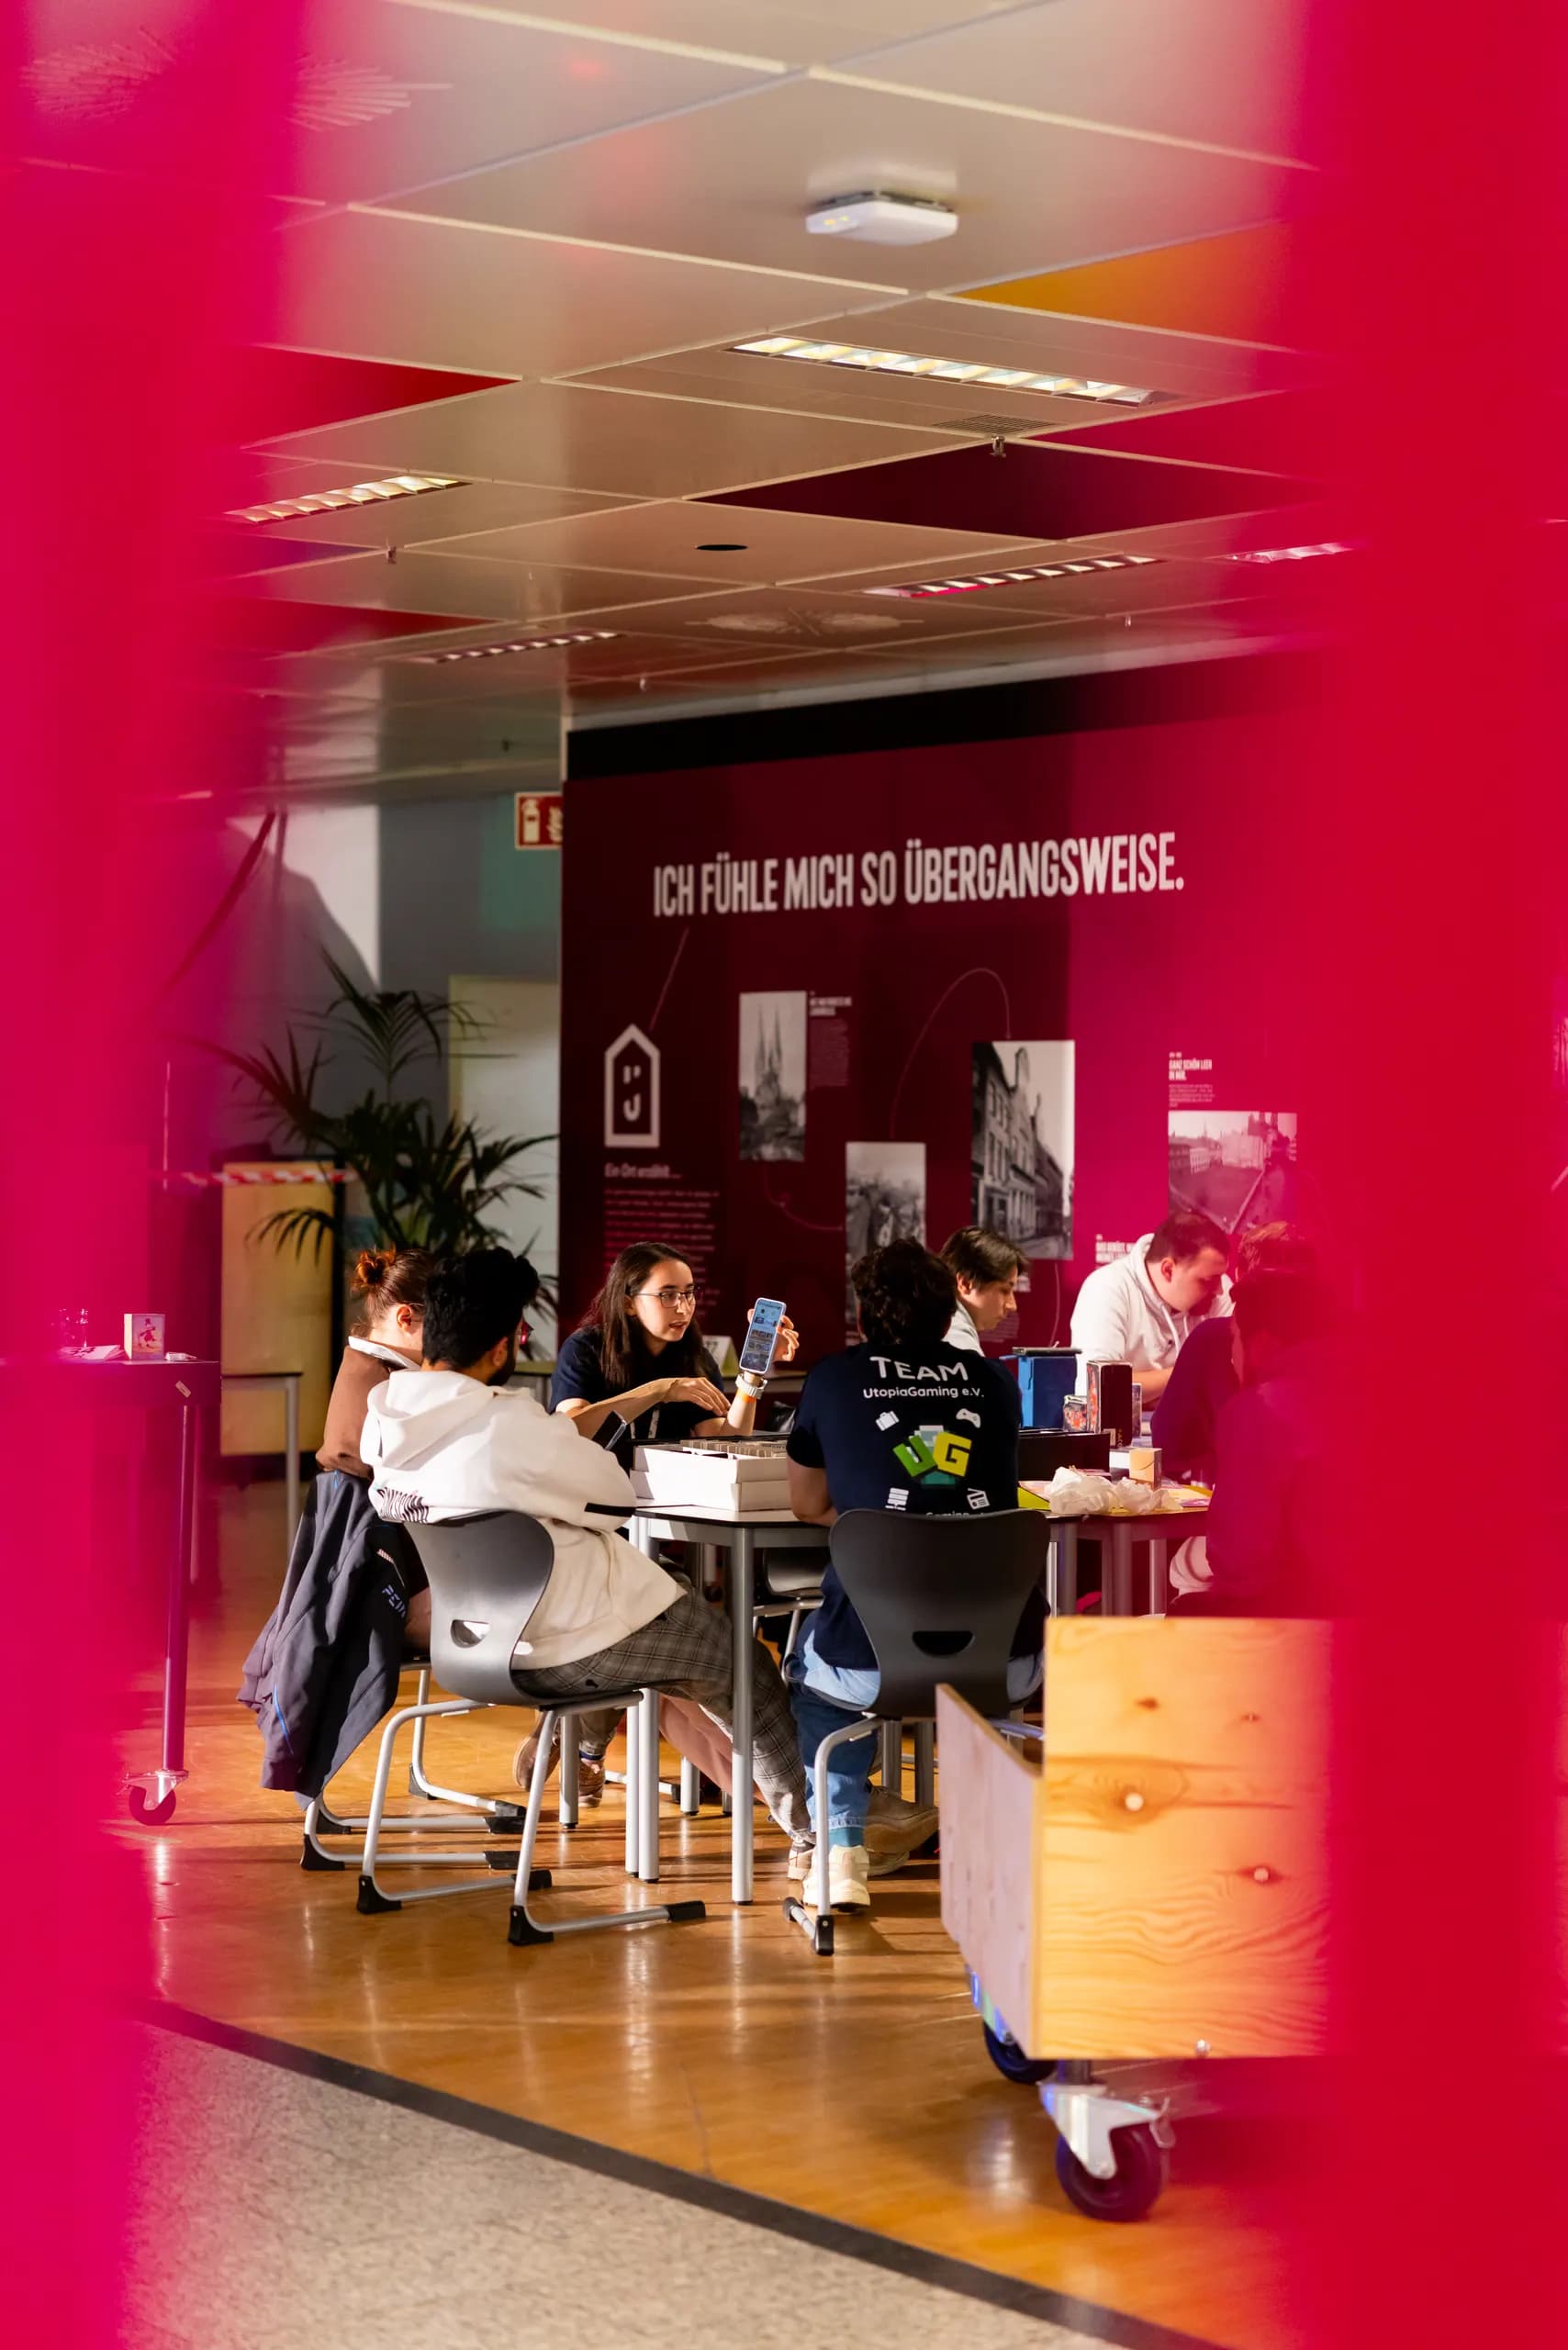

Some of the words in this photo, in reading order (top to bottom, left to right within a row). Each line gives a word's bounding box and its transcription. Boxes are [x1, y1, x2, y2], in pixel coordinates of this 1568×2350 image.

[654, 865, 695, 917] ICH
[700, 851, 778, 915] FÜHLE
[783, 853, 855, 911] MICH
[860, 850, 897, 907] SO
[904, 831, 1184, 905] ÜBERGANGSWEISE.
[869, 1356, 969, 1382] TEAM
[863, 1386, 958, 1399] UtopiaGaming
[961, 1387, 985, 1398] e.V.
